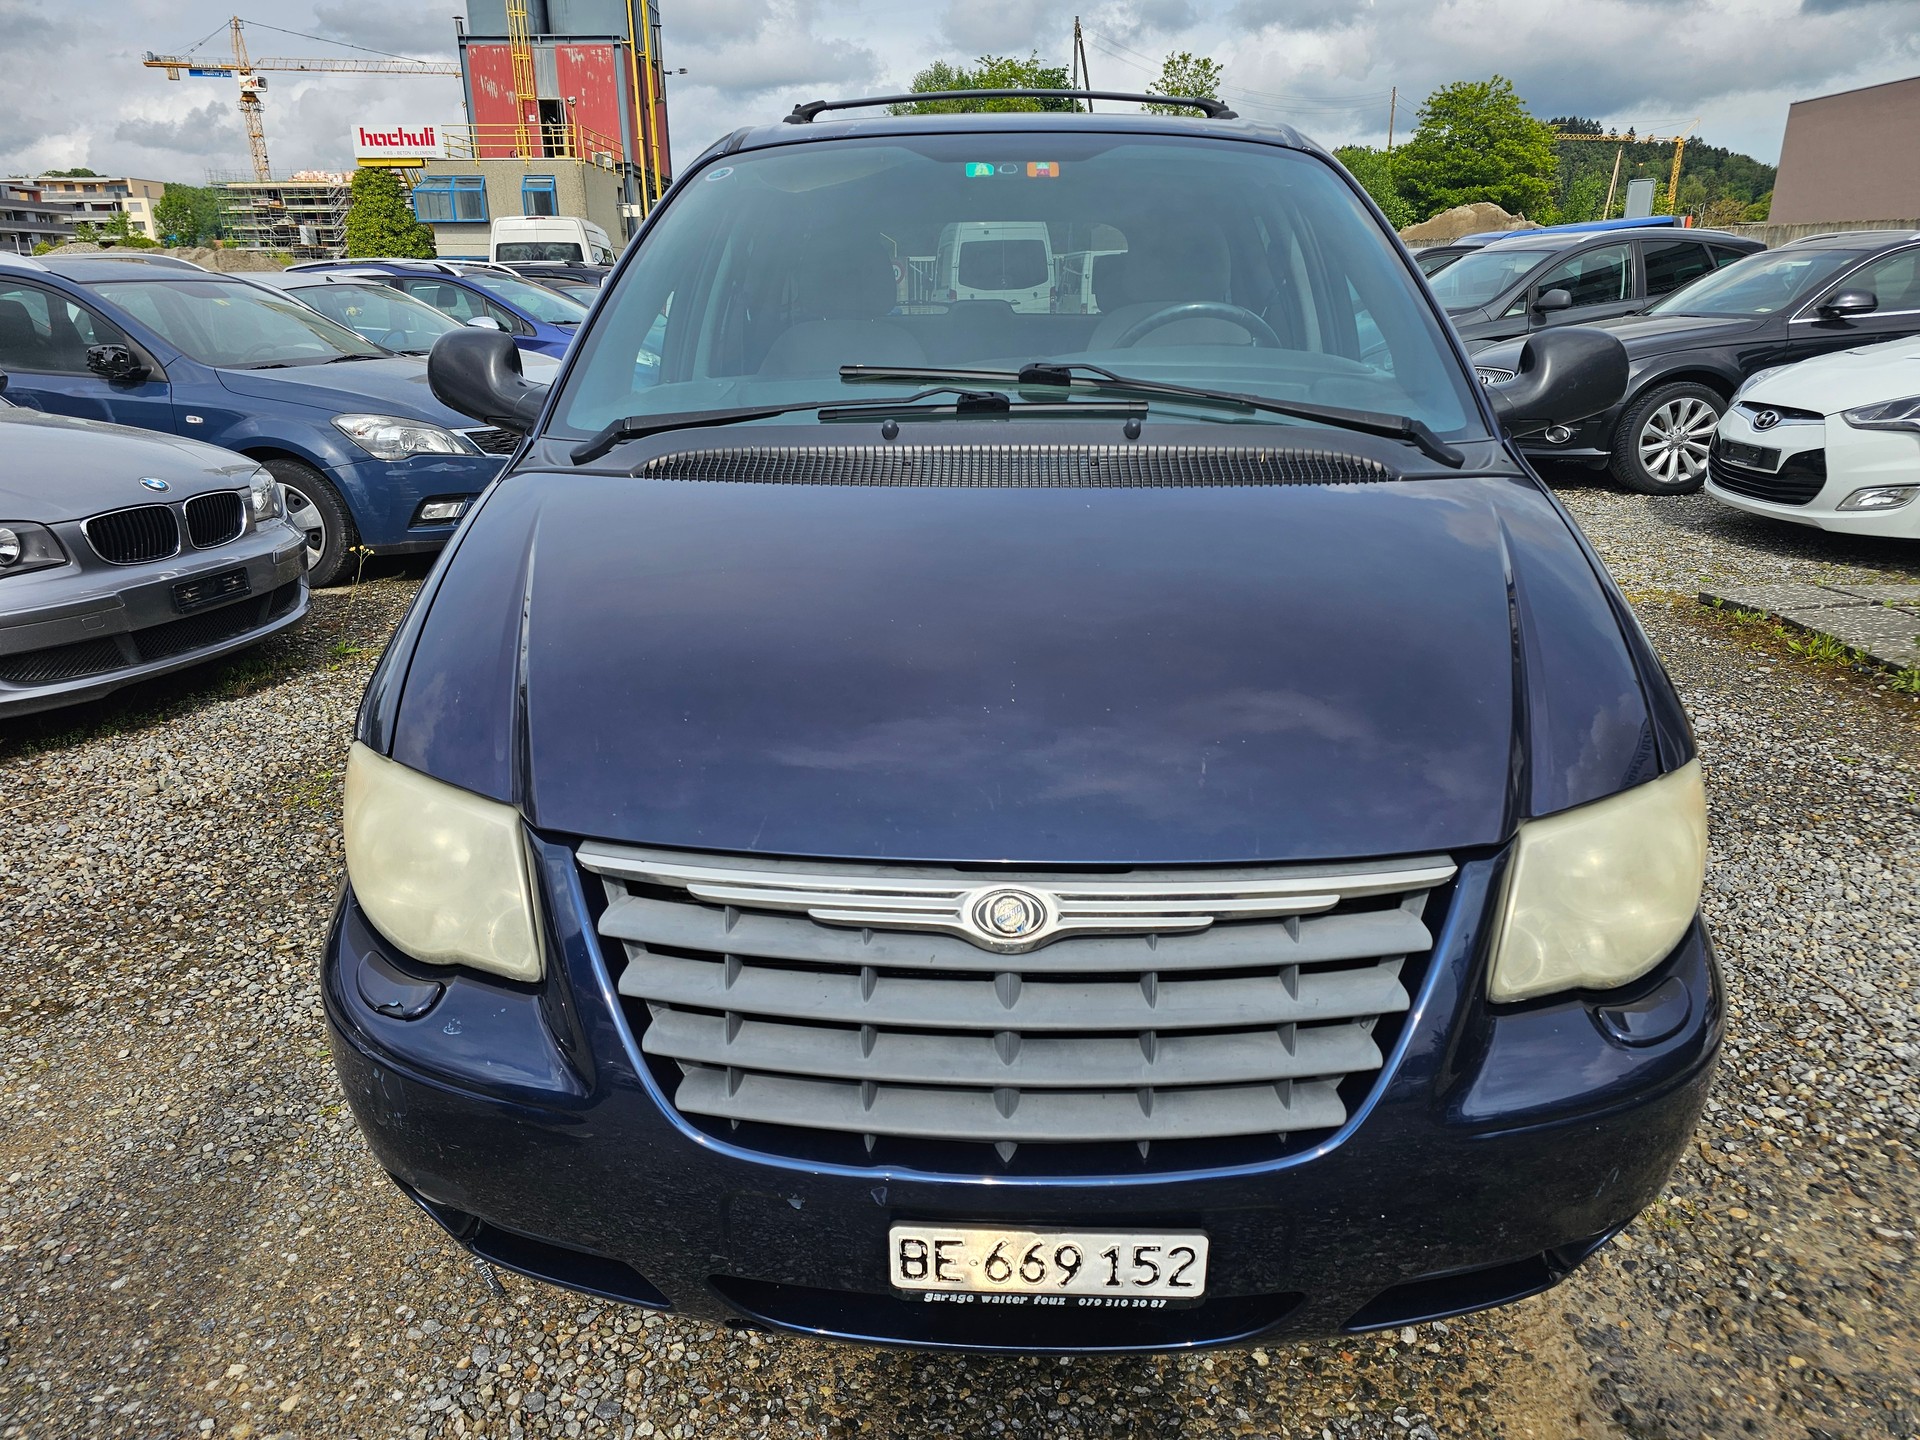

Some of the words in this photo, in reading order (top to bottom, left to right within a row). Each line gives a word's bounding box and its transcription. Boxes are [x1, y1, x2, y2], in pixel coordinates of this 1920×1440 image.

[900, 1238, 964, 1283] BE
[984, 1239, 1083, 1288] 669
[1100, 1245, 1197, 1289] 152
[924, 1292, 974, 1304] garage
[1078, 1298, 1102, 1307] 079
[1105, 1299, 1129, 1308] 310
[1132, 1300, 1148, 1308] 30
[1150, 1300, 1167, 1309] 87
